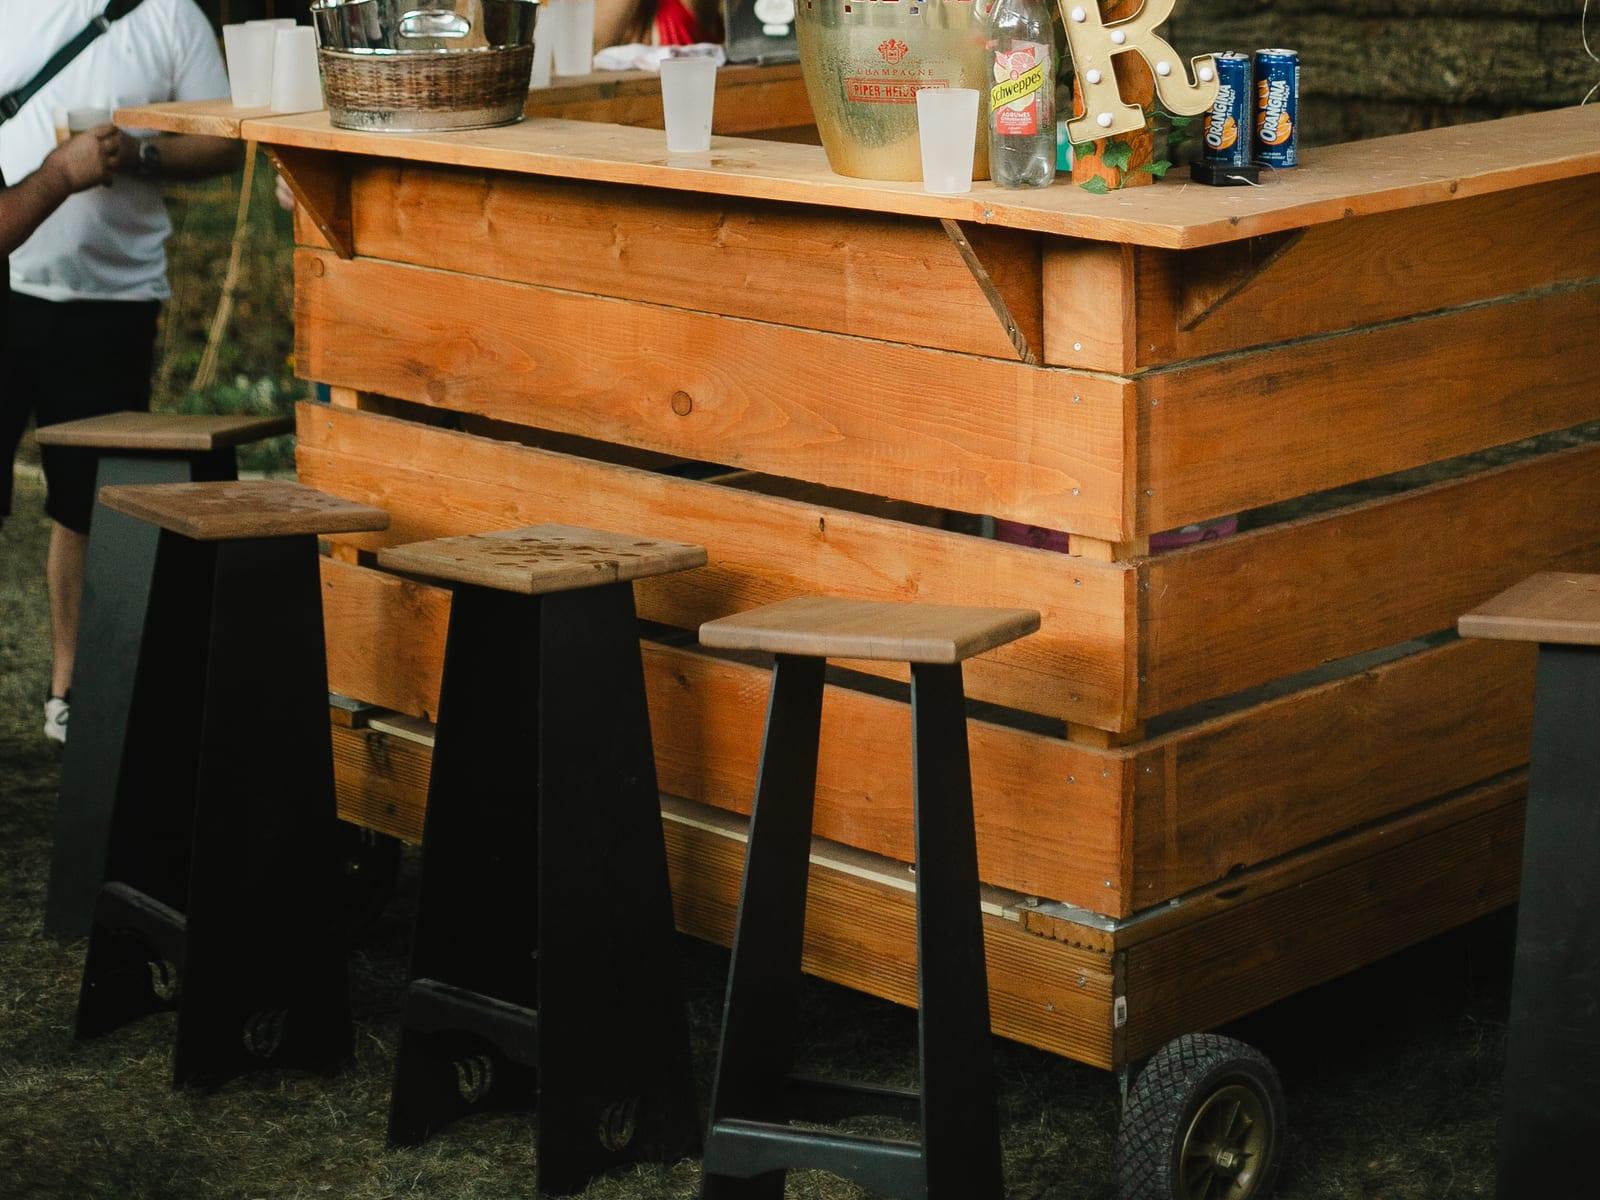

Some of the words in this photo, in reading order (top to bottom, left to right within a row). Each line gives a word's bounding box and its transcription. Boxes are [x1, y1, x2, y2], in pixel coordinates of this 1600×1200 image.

[854, 84, 942, 98] PIPER-HEIDS
[857, 68, 934, 77] CHAMPAGNE
[992, 70, 1042, 107] Schweppes
[1206, 84, 1232, 147] ORANGINA
[1259, 80, 1287, 142] ORANGINA
